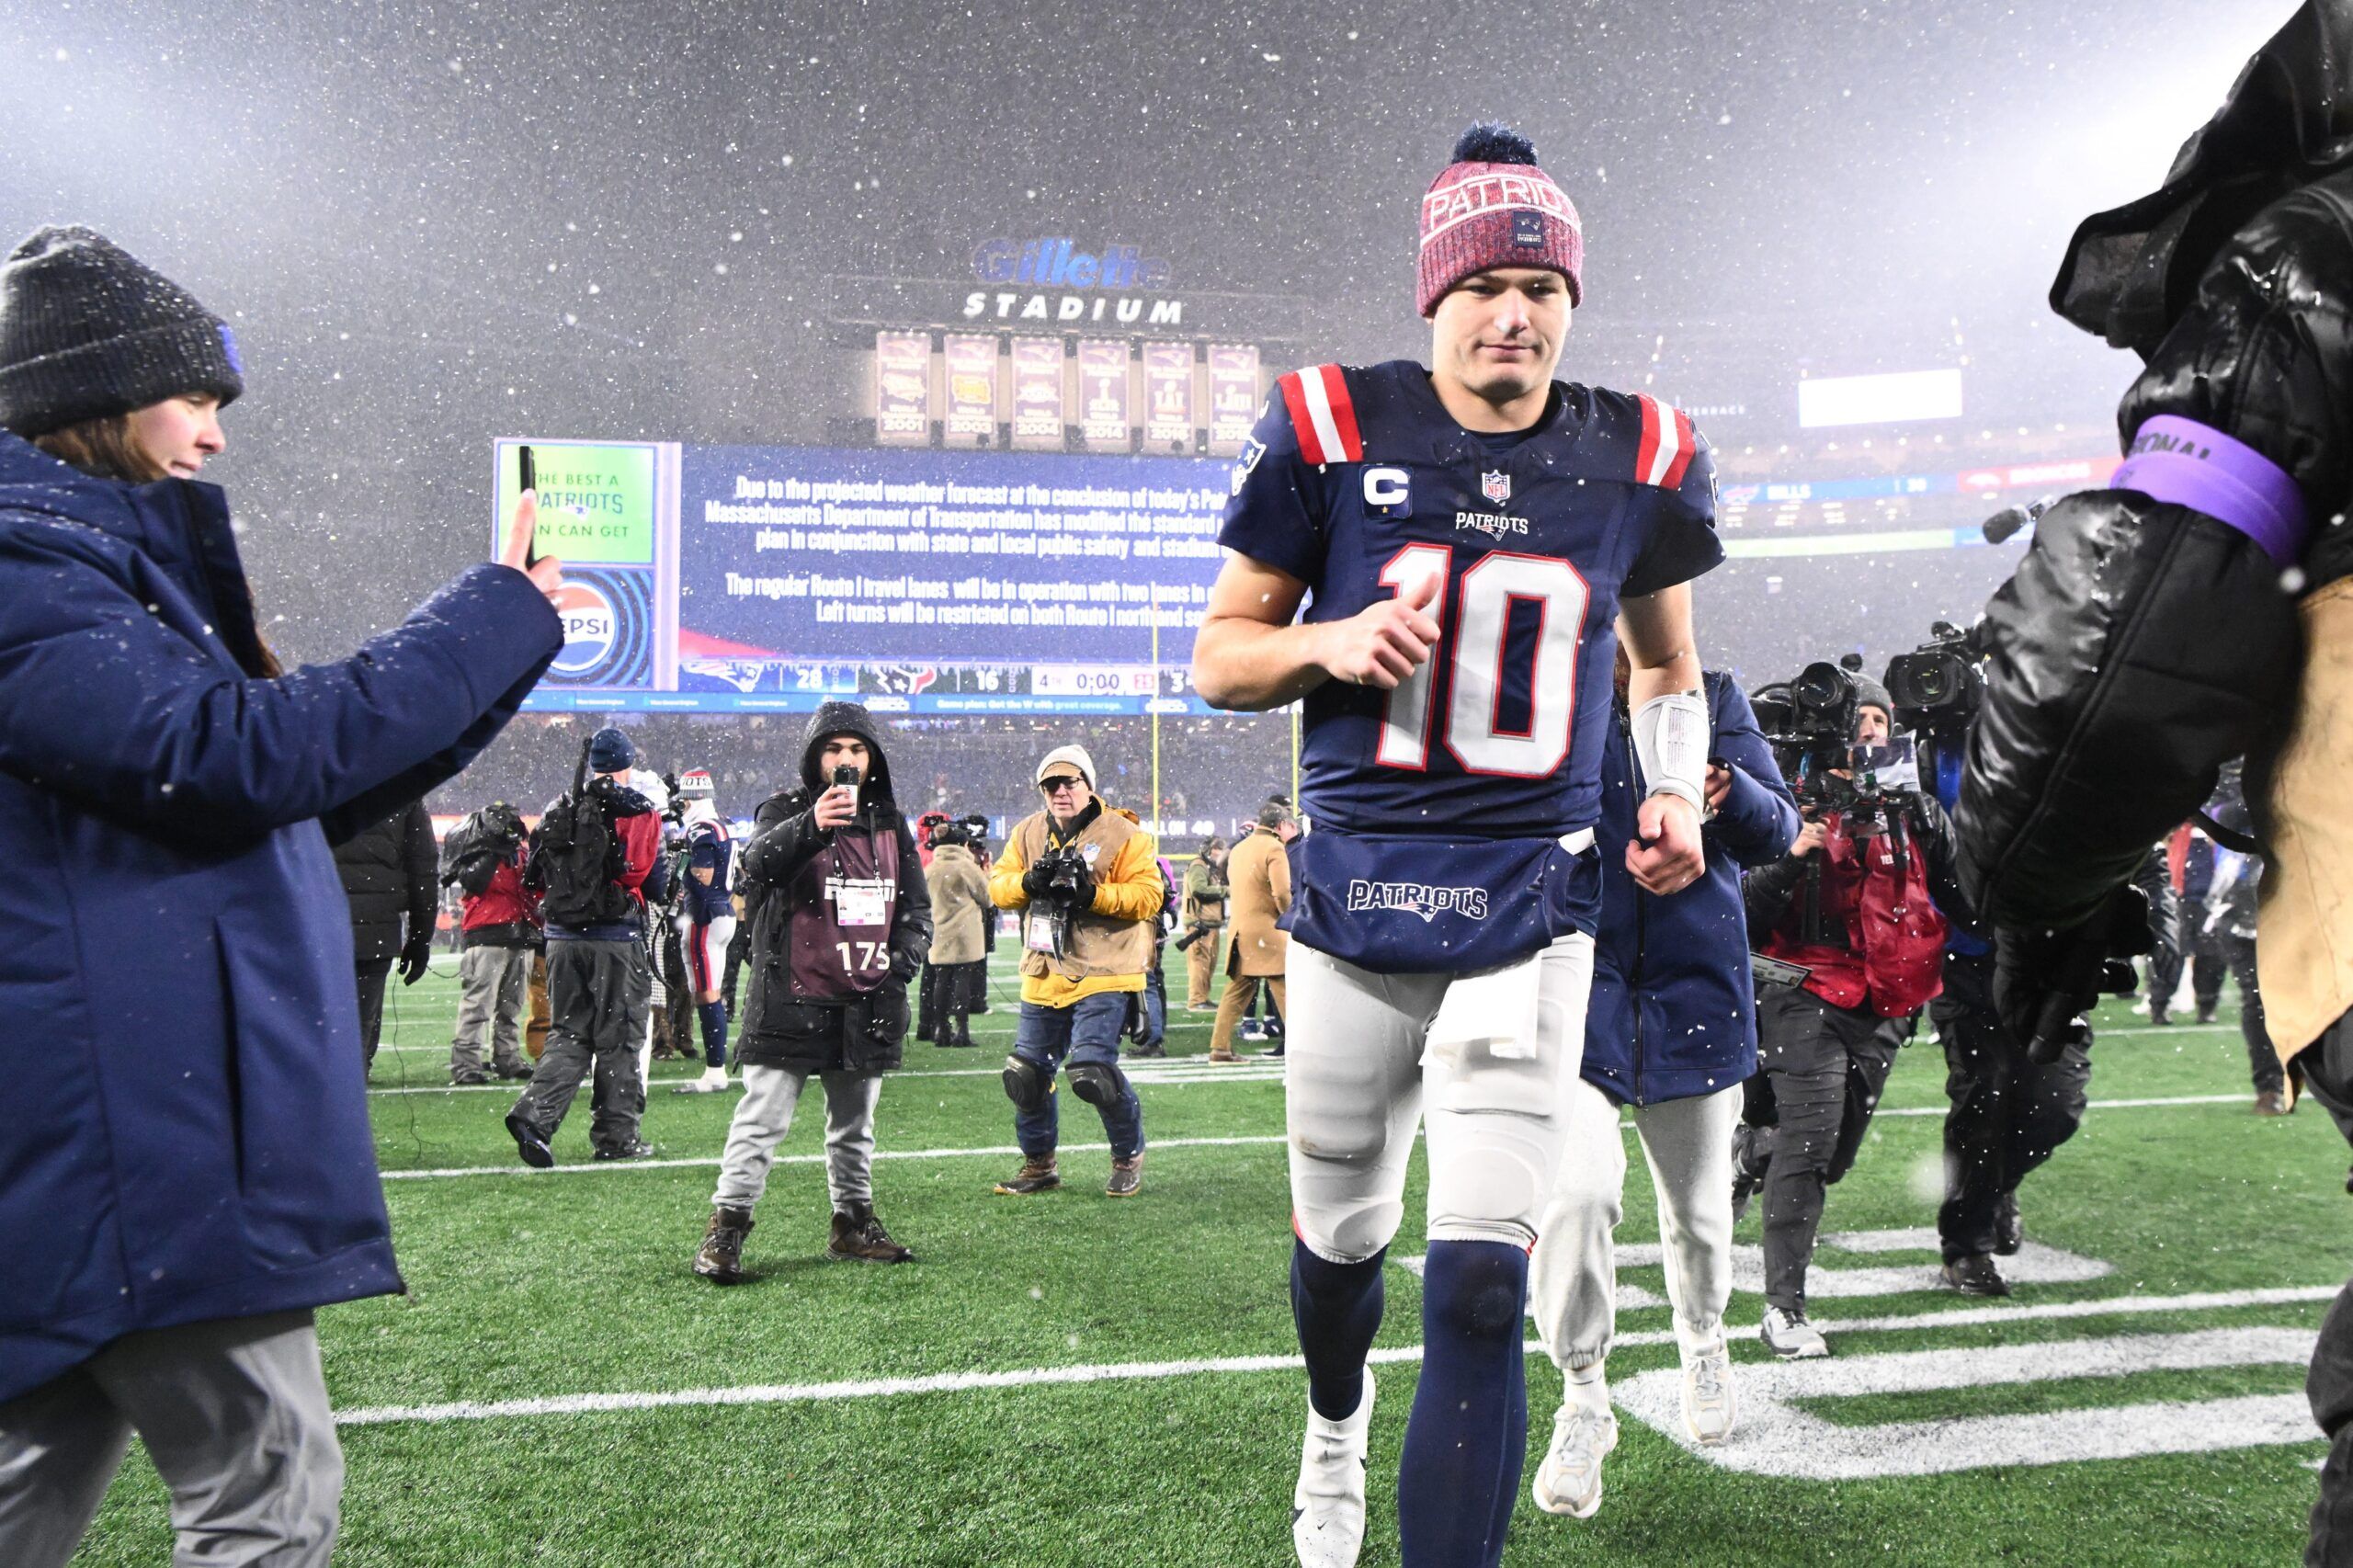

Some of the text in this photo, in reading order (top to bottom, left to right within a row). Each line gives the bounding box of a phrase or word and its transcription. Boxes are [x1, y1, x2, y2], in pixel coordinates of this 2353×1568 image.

[972, 236, 1172, 290] Gillette
[962, 292, 1183, 324] STADIUM
[883, 418, 924, 431] 2001
[1017, 423, 1060, 436] 2004
[536, 473, 620, 485] HE BEST A
[1364, 467, 1408, 506] C
[1488, 484, 1506, 497] NFL
[537, 493, 624, 515] ATRIOTS
[736, 475, 766, 499] Due
[767, 479, 782, 499] to
[785, 477, 811, 500] the
[812, 480, 883, 504] projected
[885, 481, 946, 504] weather
[947, 482, 1008, 506] forecast
[1009, 485, 1025, 506] at
[1026, 484, 1050, 506] the
[1051, 485, 1130, 508] conclusion
[1131, 487, 1148, 509] of
[1149, 488, 1199, 513] today's
[705, 500, 822, 525] Massachusetts
[824, 503, 909, 530] Department
[911, 505, 926, 528] of
[928, 506, 1032, 532] Transportation
[1034, 508, 1062, 530] has
[1063, 510, 1126, 533] modified
[1128, 512, 1151, 533] the
[1153, 513, 1215, 534] standard
[1455, 511, 1529, 535] PATRIOTS
[539, 525, 630, 538] N CAN GET
[756, 527, 789, 551] plan
[791, 528, 805, 549] in
[808, 529, 895, 554] conjunction
[896, 529, 929, 551] with
[931, 531, 970, 552] state
[972, 532, 998, 553] and
[1000, 532, 1036, 554] local
[1038, 535, 1083, 558] public
[1084, 537, 1130, 560] safety
[1133, 537, 1161, 557] and
[1162, 538, 1219, 558] stadium
[725, 572, 753, 596] The
[755, 574, 809, 600] regular
[811, 574, 854, 597] Route
[864, 575, 906, 597] travel
[908, 576, 949, 598] lanes
[953, 577, 980, 599] will
[982, 578, 1000, 599] be
[1003, 579, 1016, 599] in
[1017, 580, 1086, 604] operation
[1088, 580, 1120, 601] with
[1121, 583, 1149, 602] two
[1151, 581, 1189, 602] lanes
[1191, 583, 1205, 602] in
[816, 600, 845, 622] Left
[847, 603, 886, 623] turns
[887, 601, 914, 623] will
[915, 602, 935, 623] be
[937, 604, 1008, 625] restricted
[1010, 608, 1029, 626] on
[1030, 604, 1064, 626] both
[1065, 605, 1107, 627] Route
[1117, 606, 1154, 627] north
[1157, 607, 1183, 627] and
[1375, 541, 1590, 778] 10
[796, 668, 823, 690] 28
[976, 670, 999, 690] 16
[1040, 674, 1049, 687] 4
[1076, 673, 1120, 689] 0:00
[1347, 879, 1488, 920] PATRIOTS
[835, 941, 891, 971] 175
